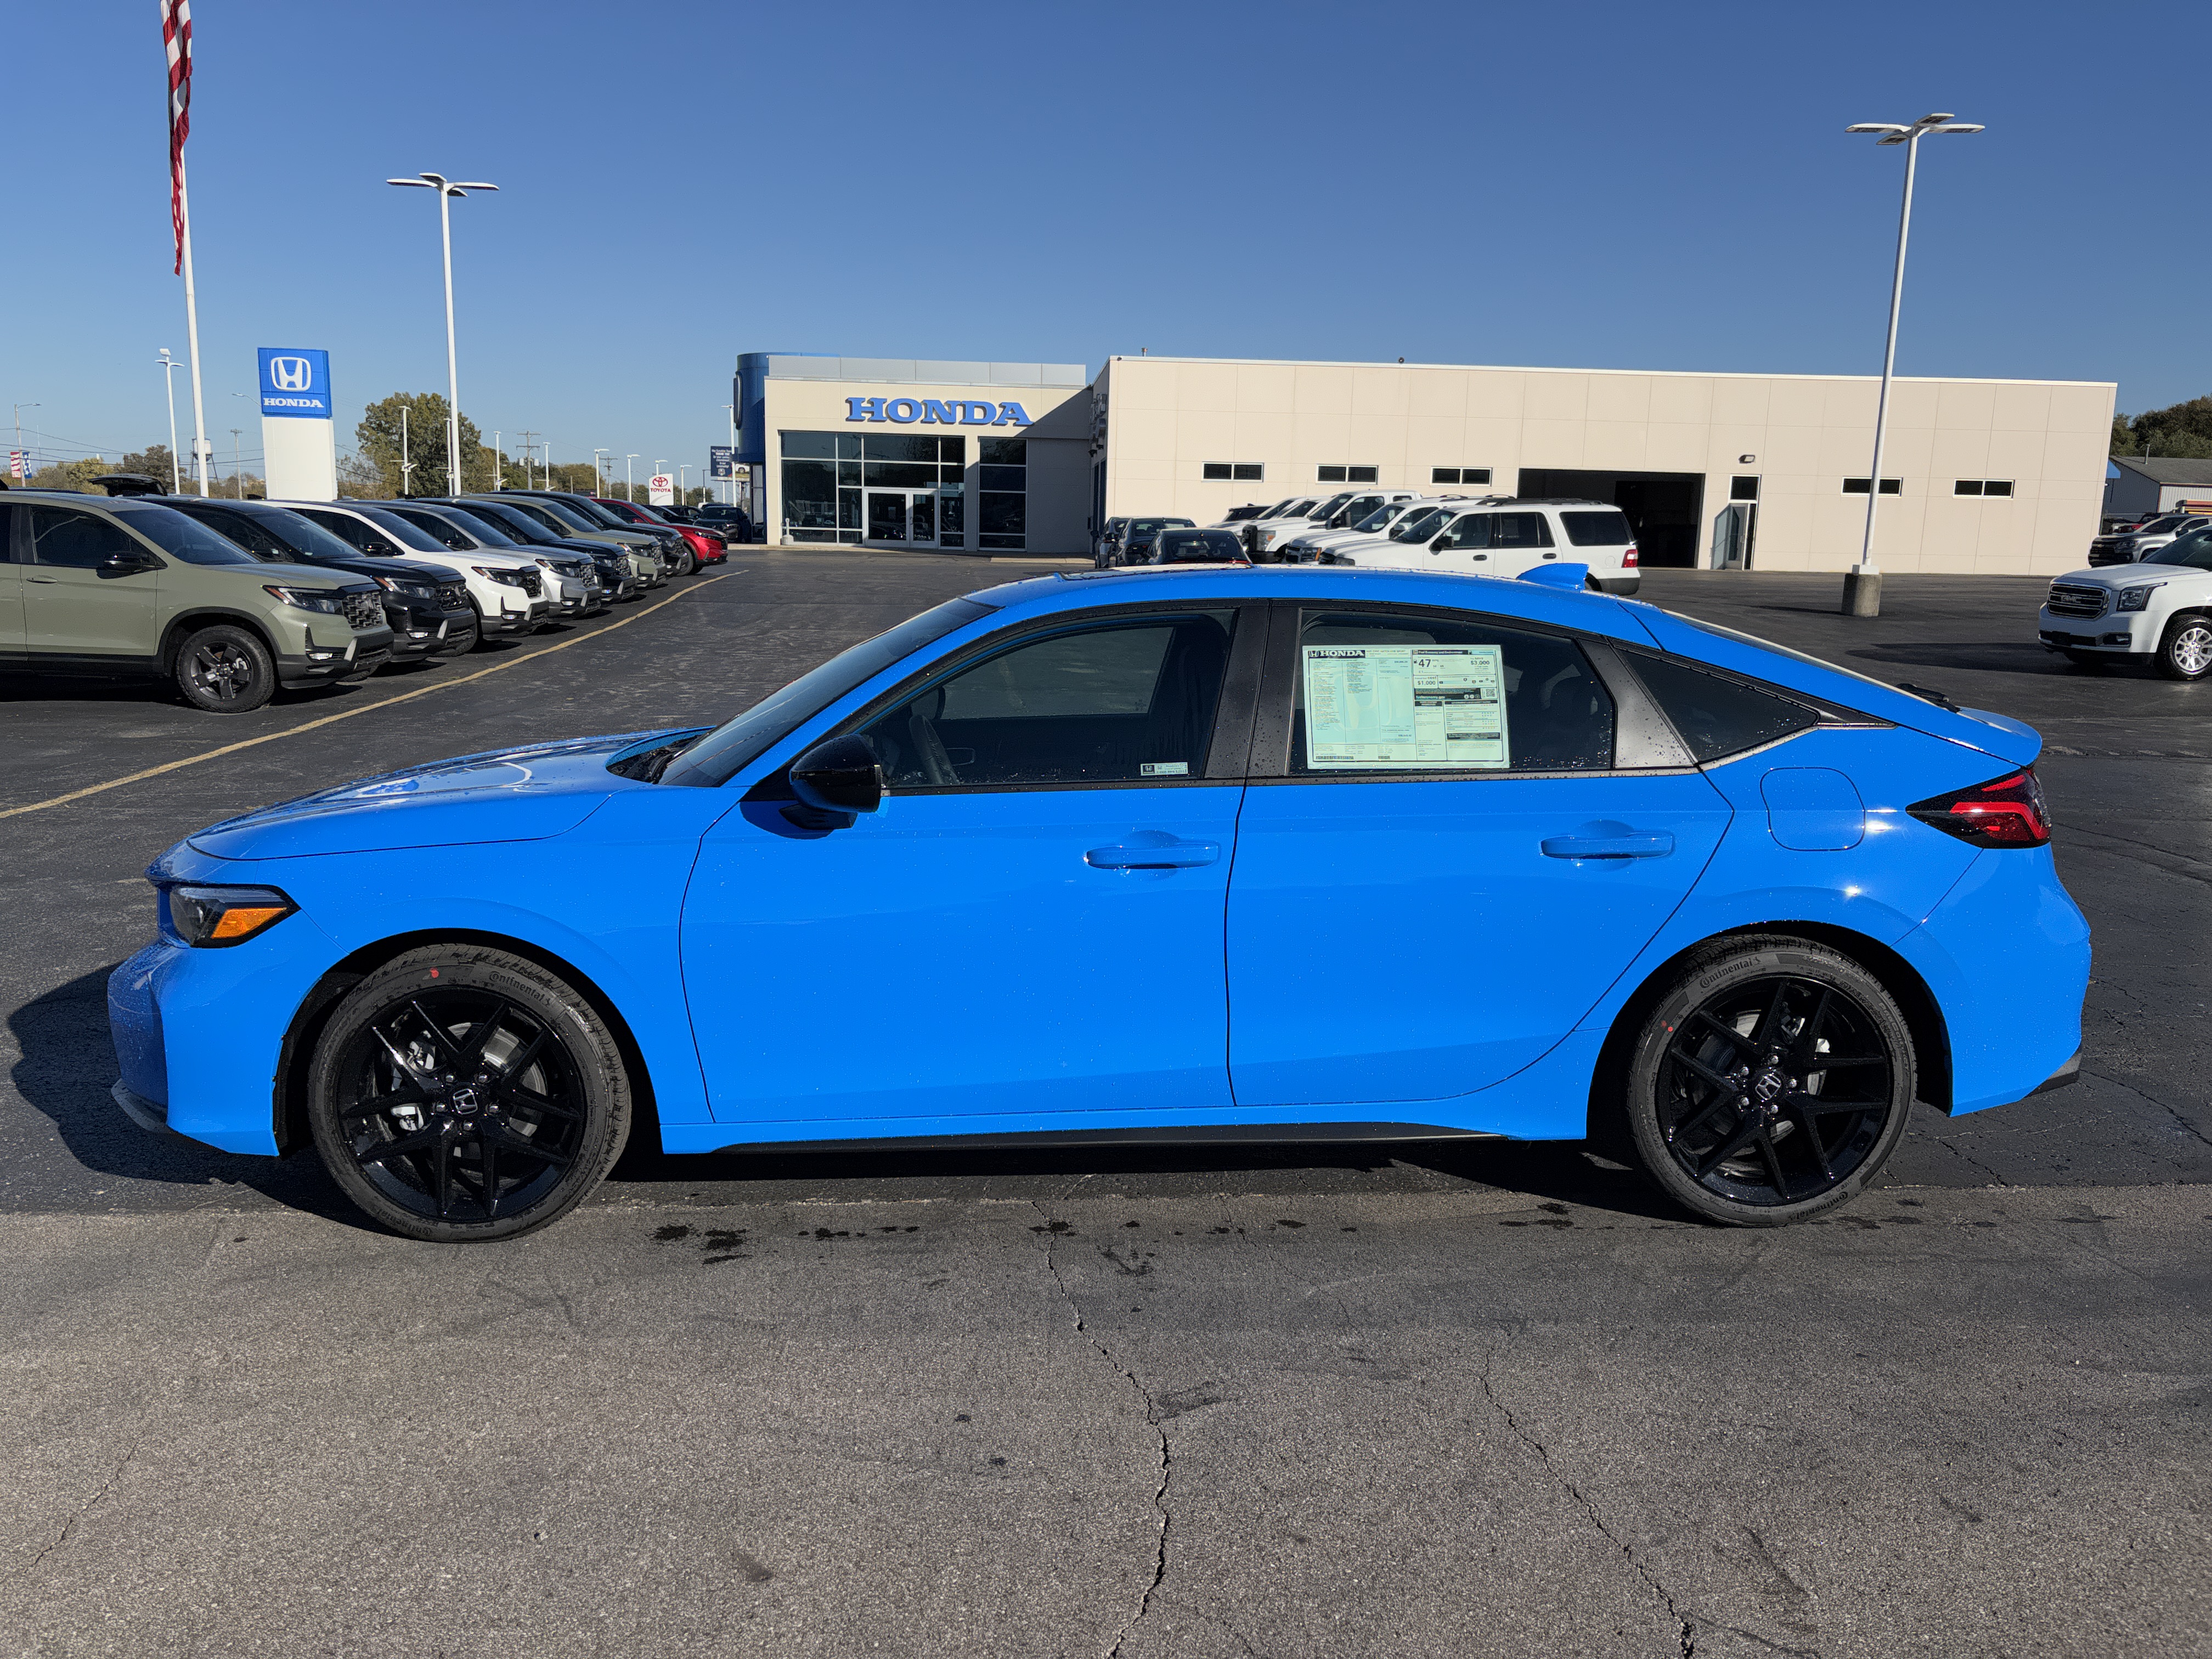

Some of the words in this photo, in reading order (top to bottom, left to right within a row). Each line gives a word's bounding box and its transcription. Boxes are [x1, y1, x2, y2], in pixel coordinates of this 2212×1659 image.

[263, 397, 325, 408] HONDA
[845, 397, 1035, 427] HONDA
[2061, 595, 2082, 603] GMC
[1418, 659, 1431, 668] 47
[489, 970, 545, 1002] Continental
[1699, 957, 1753, 989] Continental
[1797, 1191, 1848, 1220] Continental
